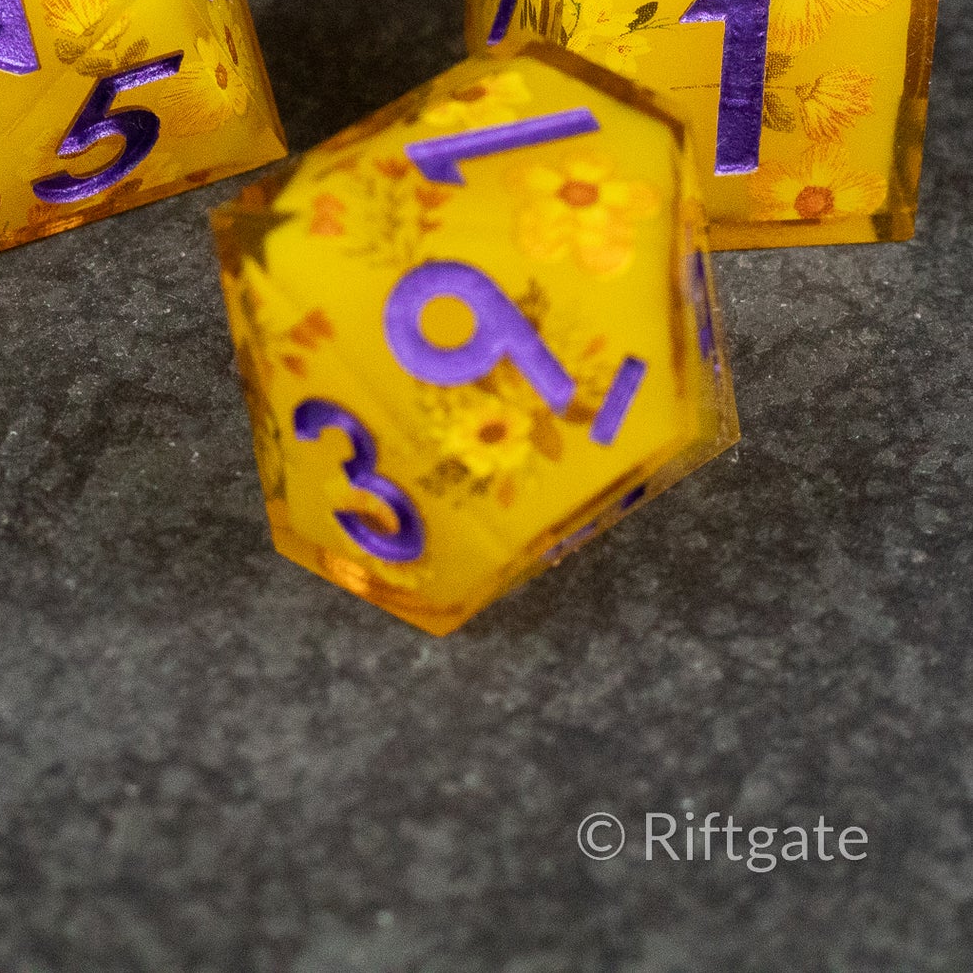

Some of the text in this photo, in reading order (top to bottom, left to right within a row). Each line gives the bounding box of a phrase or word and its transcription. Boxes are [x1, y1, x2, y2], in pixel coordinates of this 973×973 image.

[31, 50, 183, 204] 5
[404, 106, 601, 186] 1
[293, 398, 424, 562] 3
